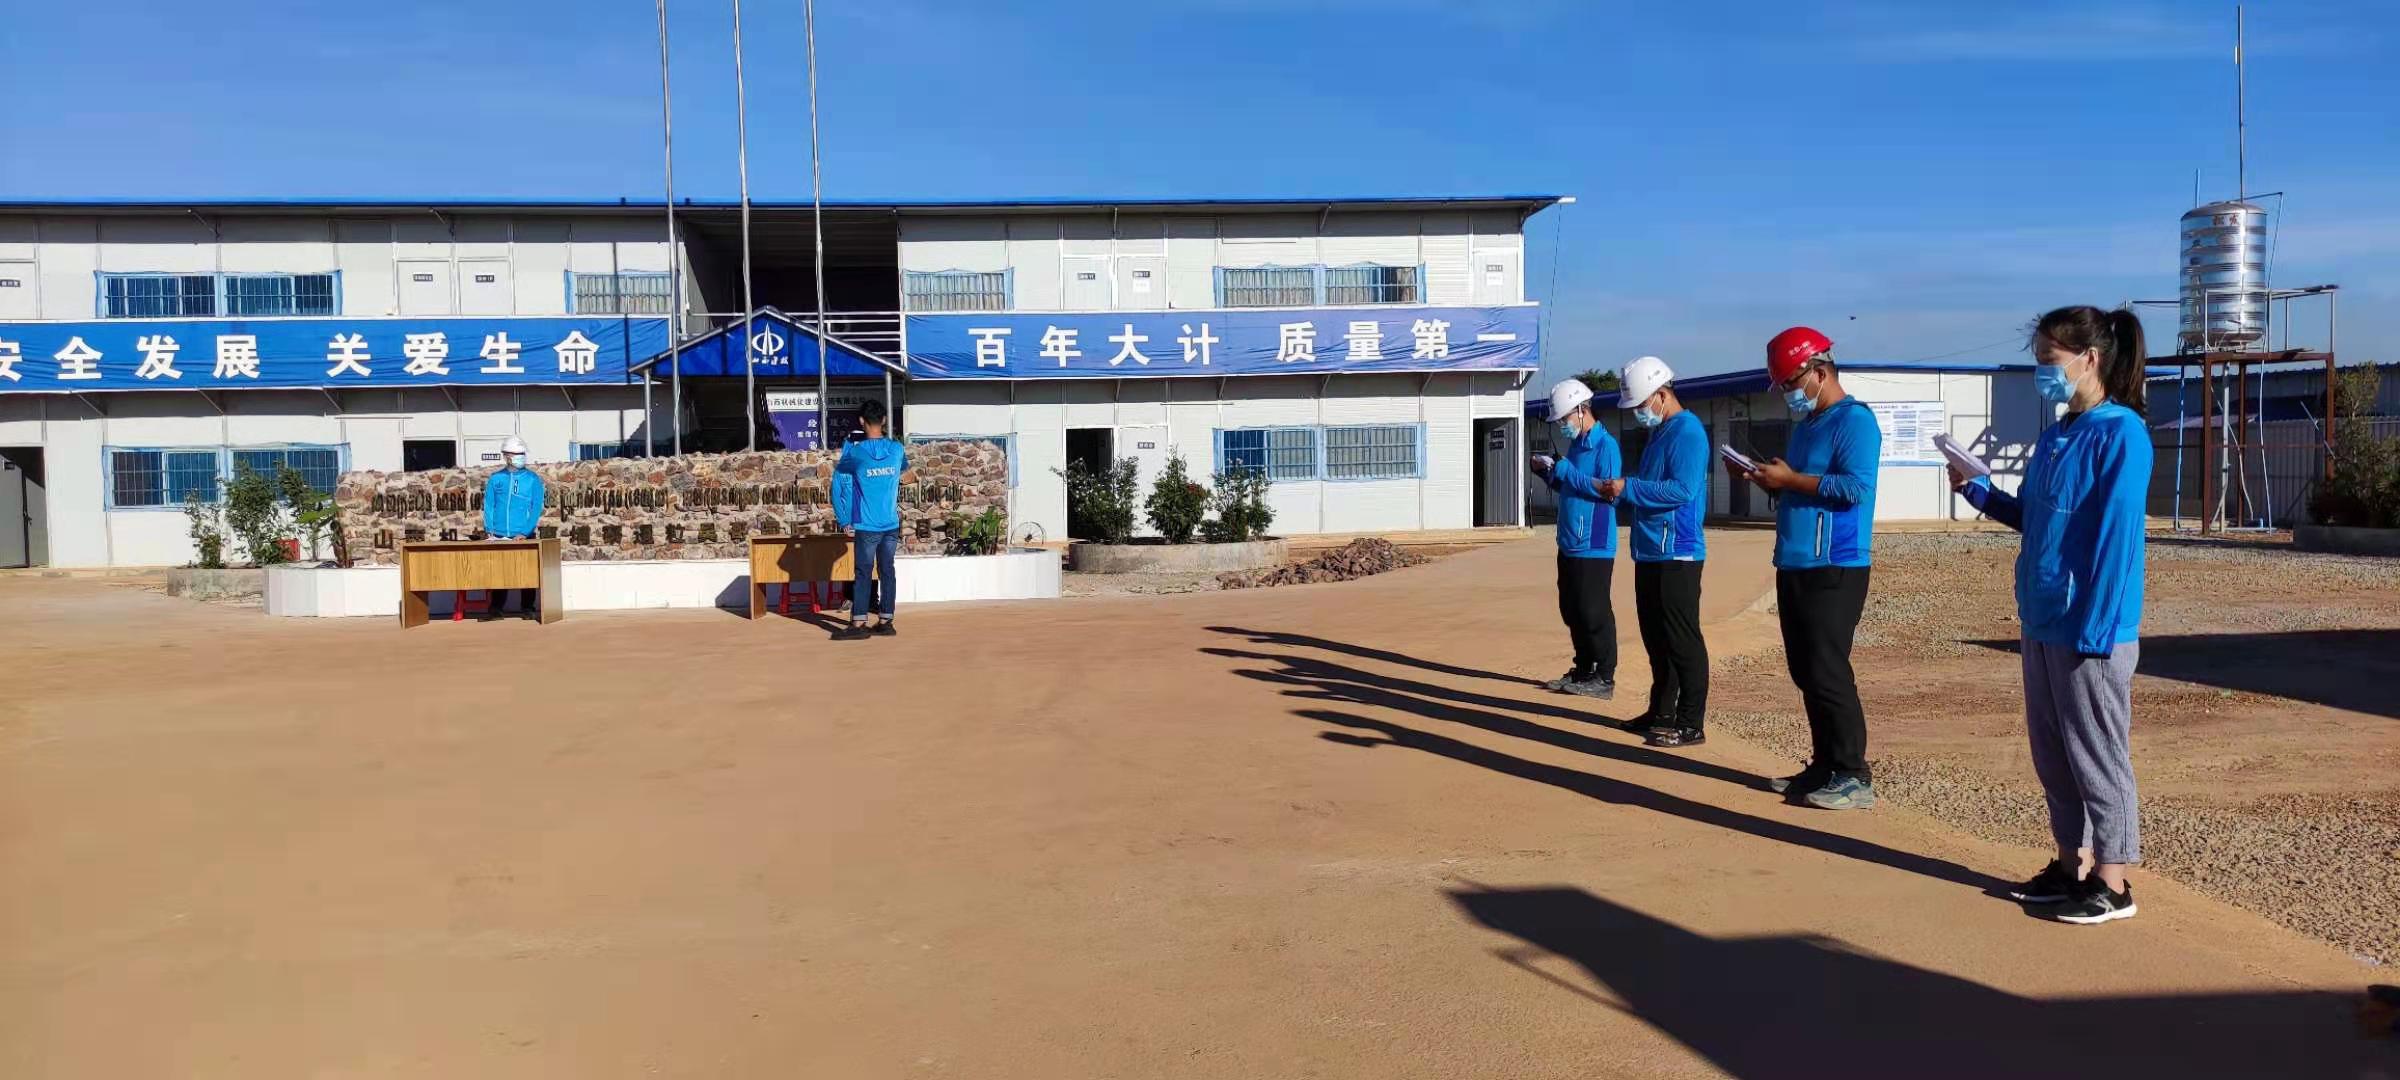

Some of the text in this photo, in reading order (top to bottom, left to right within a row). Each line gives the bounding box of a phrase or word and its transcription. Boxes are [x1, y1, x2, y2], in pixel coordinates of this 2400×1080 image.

[326, 330, 600, 377] 关爱生命
[968, 319, 1516, 367] 百年大计 质量第一
